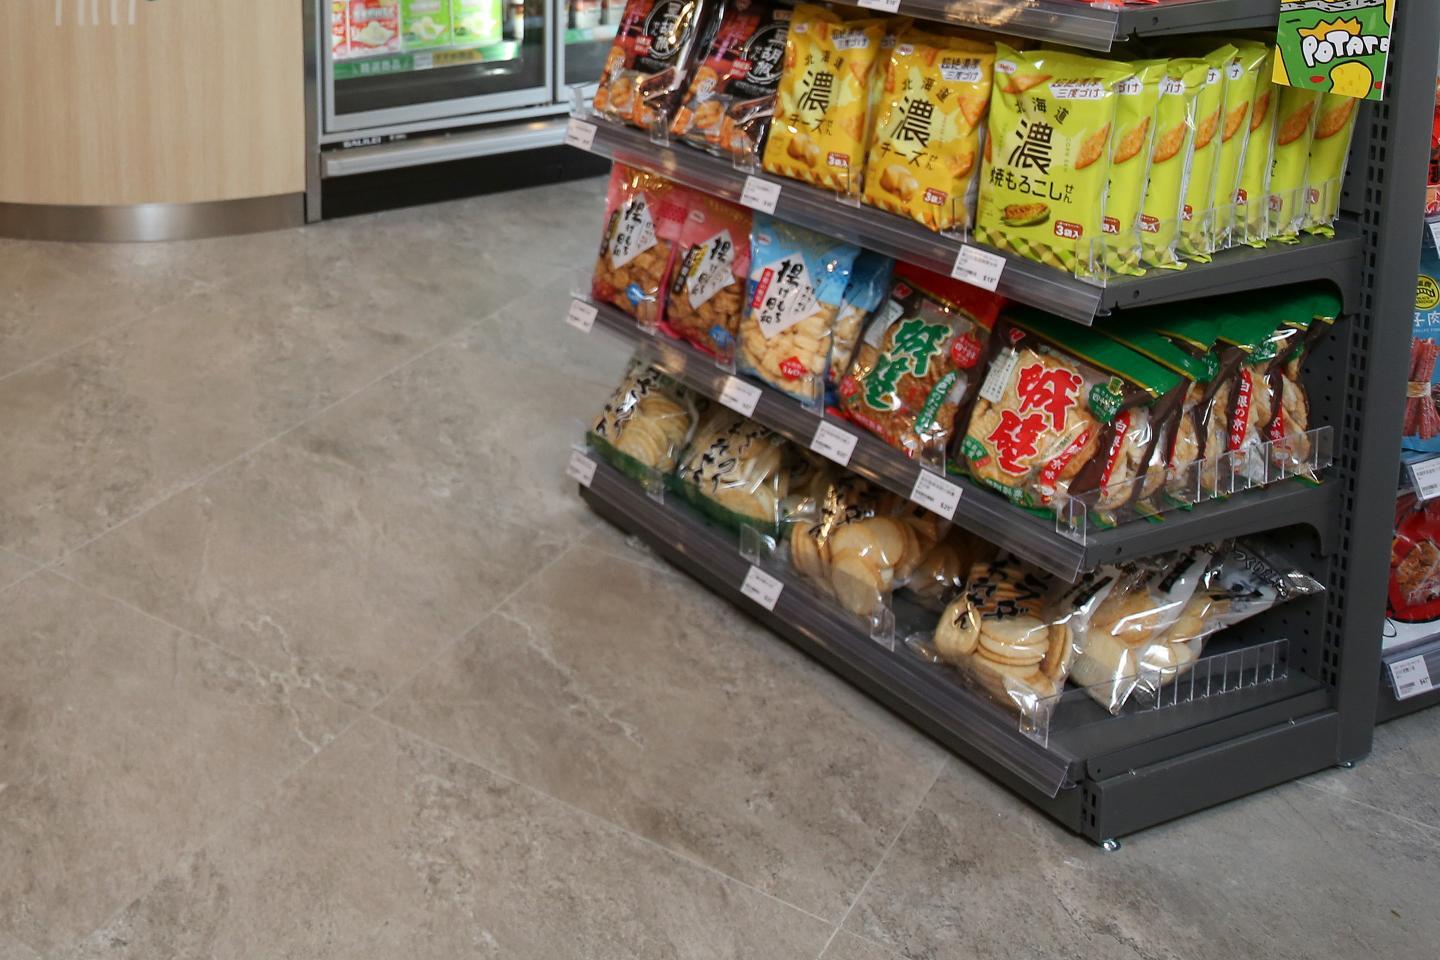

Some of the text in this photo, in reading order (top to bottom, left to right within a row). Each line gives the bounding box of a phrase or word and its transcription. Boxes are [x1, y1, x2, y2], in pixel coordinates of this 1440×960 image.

[797, 70, 834, 114] 濃
[789, 114, 826, 136] チーズ
[890, 96, 934, 148] 濃
[880, 143, 928, 167] チーズ
[1007, 119, 1053, 175] 濃
